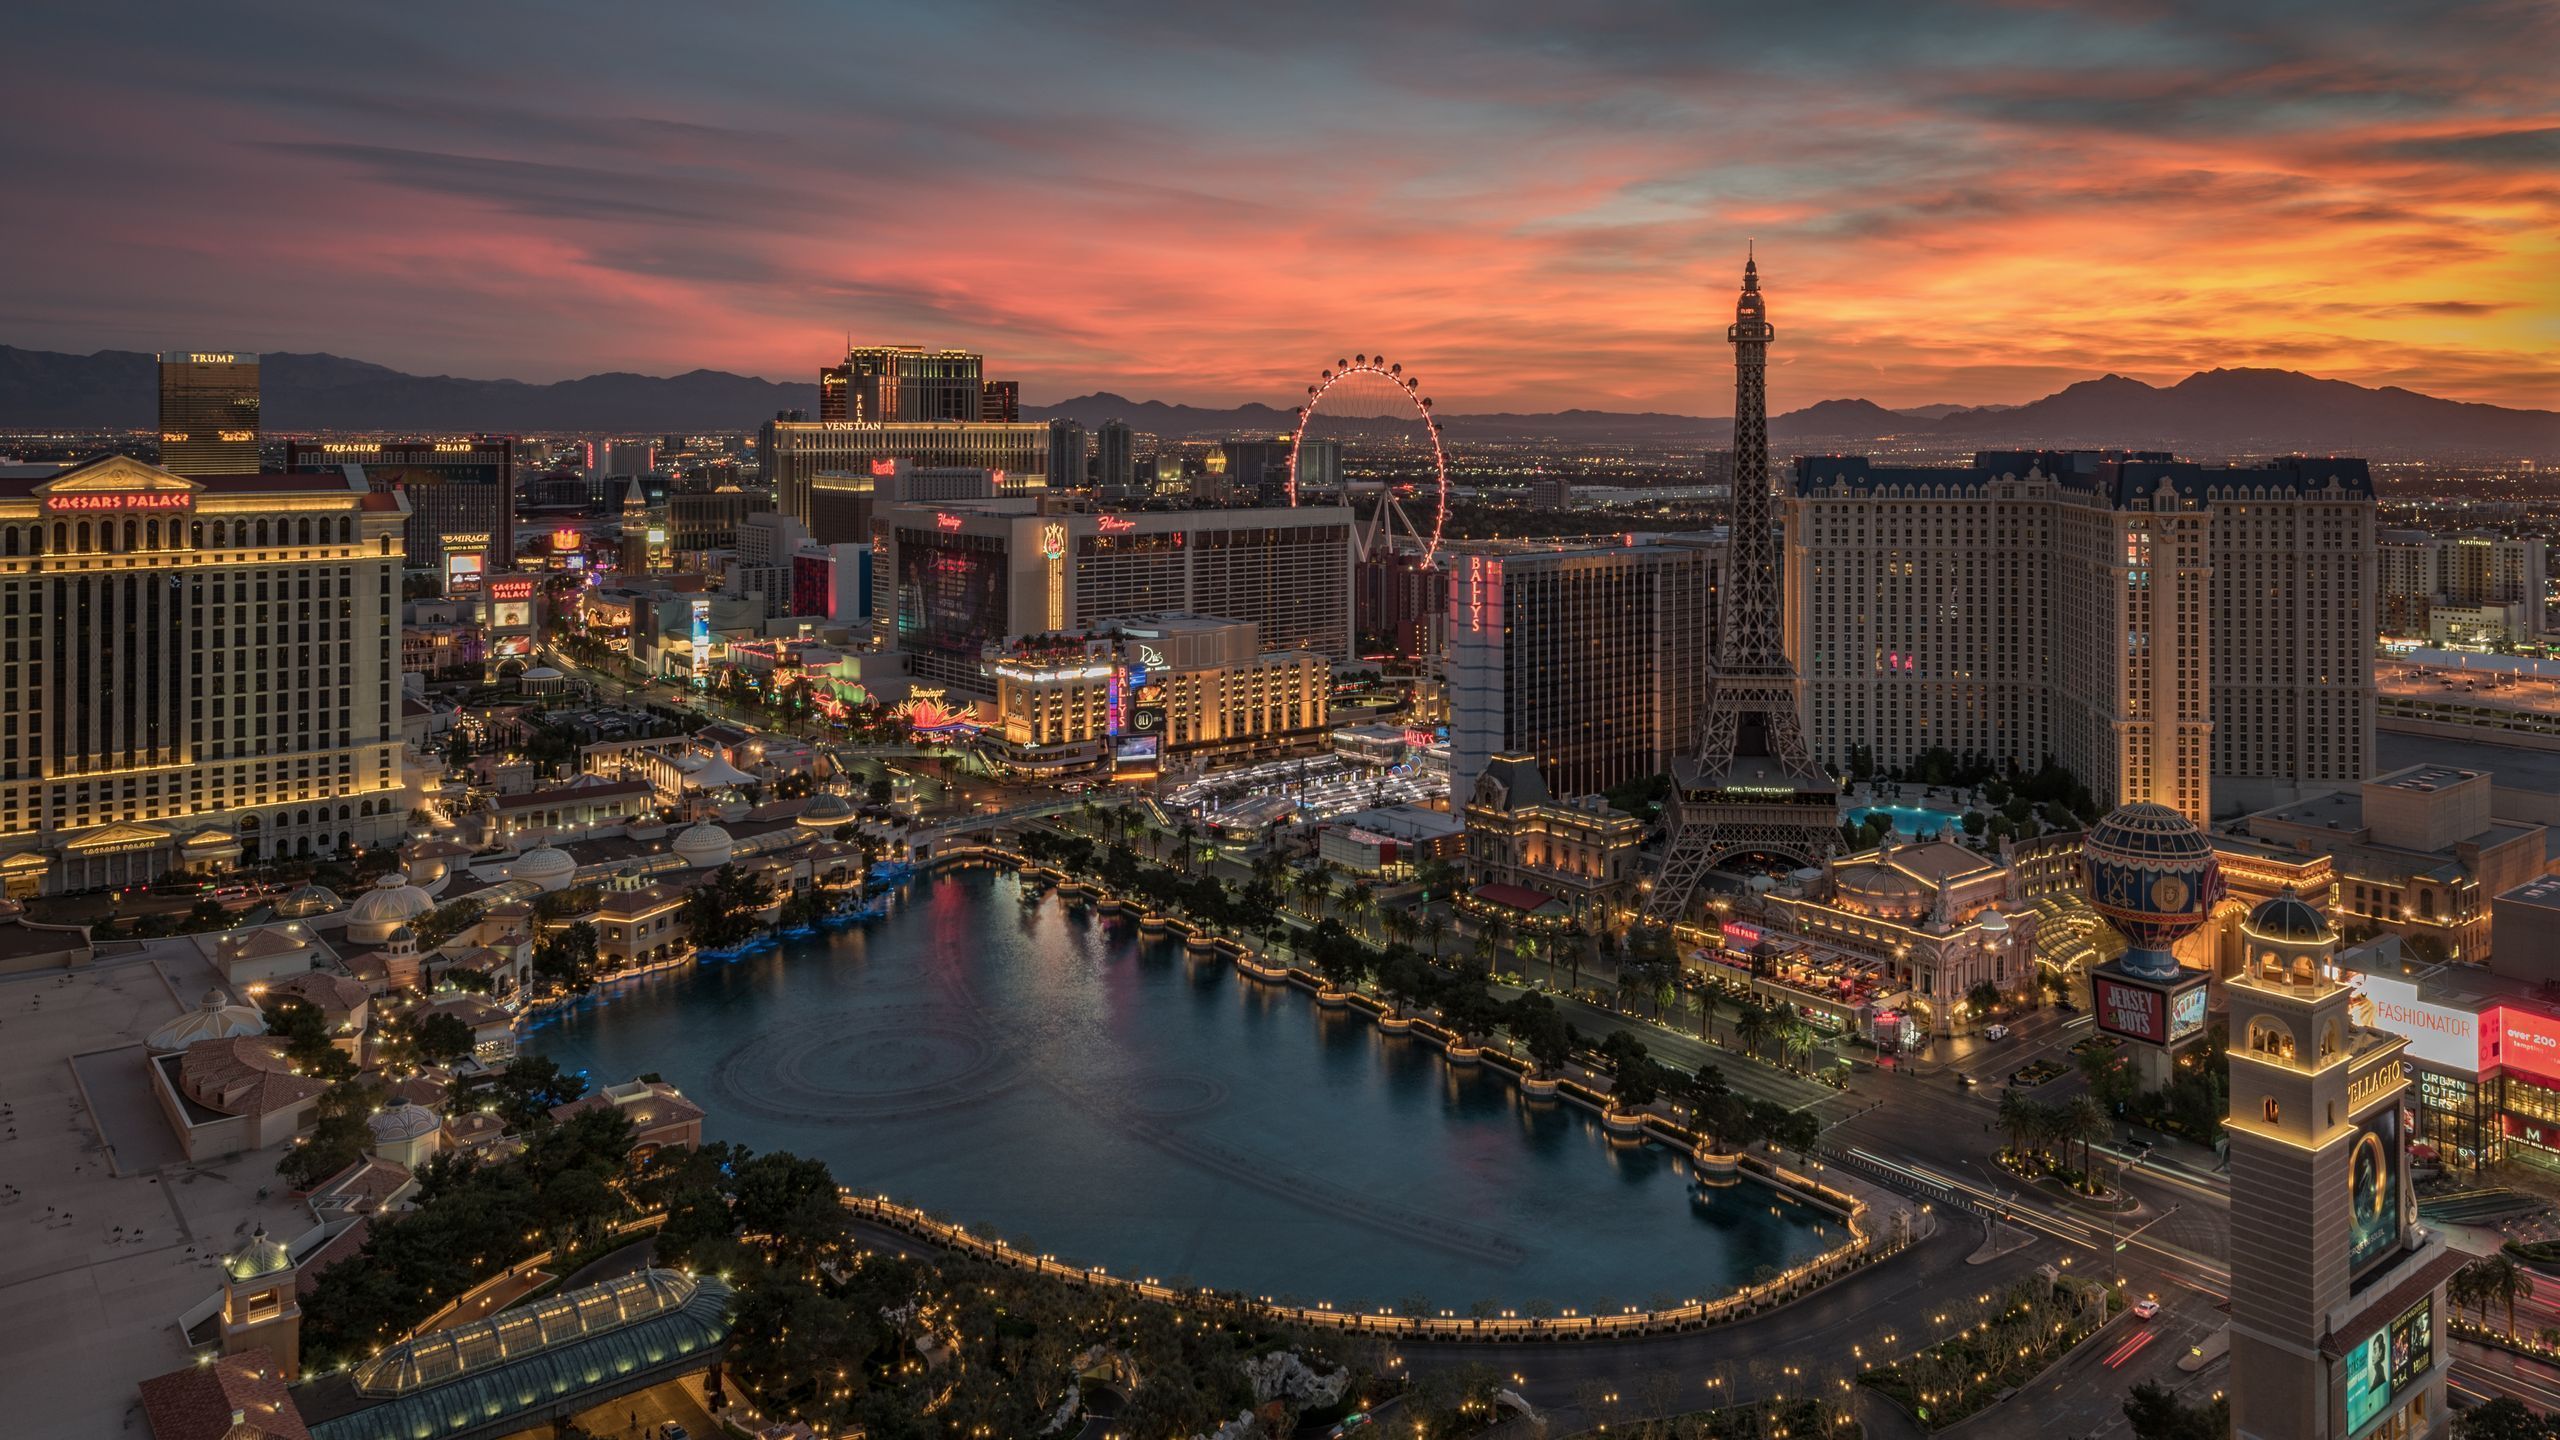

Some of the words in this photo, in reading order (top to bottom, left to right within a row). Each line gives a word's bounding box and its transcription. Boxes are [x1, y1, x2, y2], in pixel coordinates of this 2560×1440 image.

[191, 354, 235, 363] TRUMP
[823, 373, 848, 385] Encor
[826, 422, 882, 431] VENETIAN
[323, 444, 381, 453] TREASURE
[435, 444, 472, 452] ISLAND
[48, 496, 122, 509] CAESARS
[127, 494, 190, 507] PALACE
[1098, 516, 1136, 531] Flamingo
[451, 534, 490, 543] MIRAGE
[493, 582, 532, 591] CAESARS
[495, 590, 530, 599] PALACE
[2108, 986, 2152, 1014] JERSEY
[2117, 1008, 2151, 1035] BOYS
[2378, 1001, 2471, 1039] FASHIONATOR
[2507, 1029, 2531, 1041] over
[2533, 1034, 2557, 1048] 200
[2348, 1059, 2401, 1104] ELLAGIO
[2421, 1071, 2466, 1091] URBAN
[2421, 1084, 2467, 1102] OUTFIT
[2422, 1094, 2453, 1110] TERS
[2526, 1127, 2541, 1141] M
[2505, 1134, 2530, 1145] MIRACLE
[2545, 1144, 2560, 1154] SHOP
